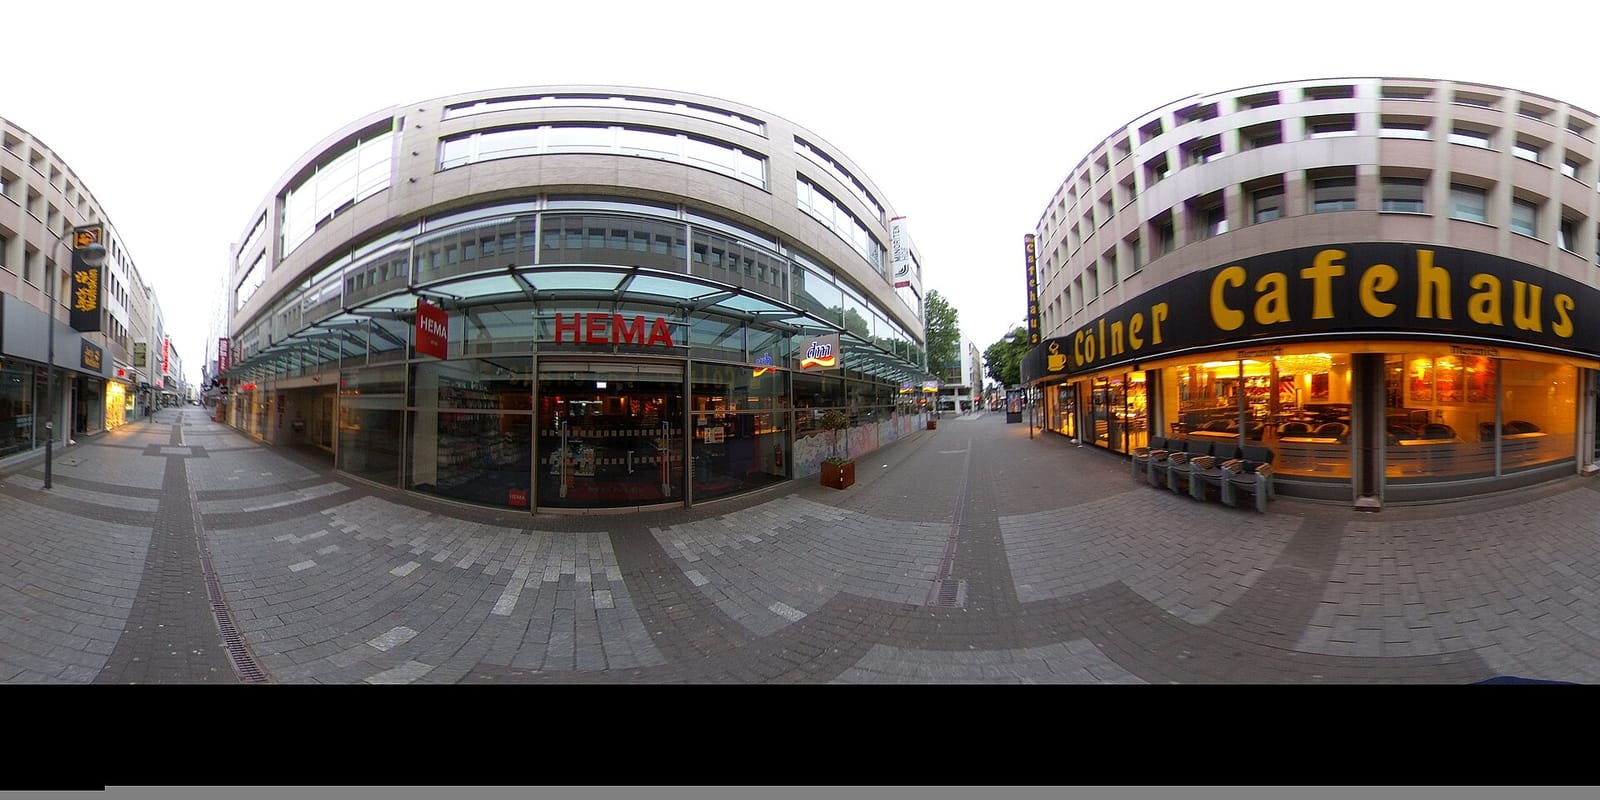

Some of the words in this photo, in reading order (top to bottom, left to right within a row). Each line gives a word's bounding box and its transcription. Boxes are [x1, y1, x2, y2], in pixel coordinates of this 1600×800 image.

[892, 225, 901, 263] MINORITEN
[1026, 243, 1039, 344] Cafehaus
[1074, 302, 1169, 367] Cölner
[1209, 249, 1576, 339] Cafehaus
[420, 314, 447, 340] HEMA
[555, 312, 675, 349] HEMA
[806, 341, 832, 360] dm
